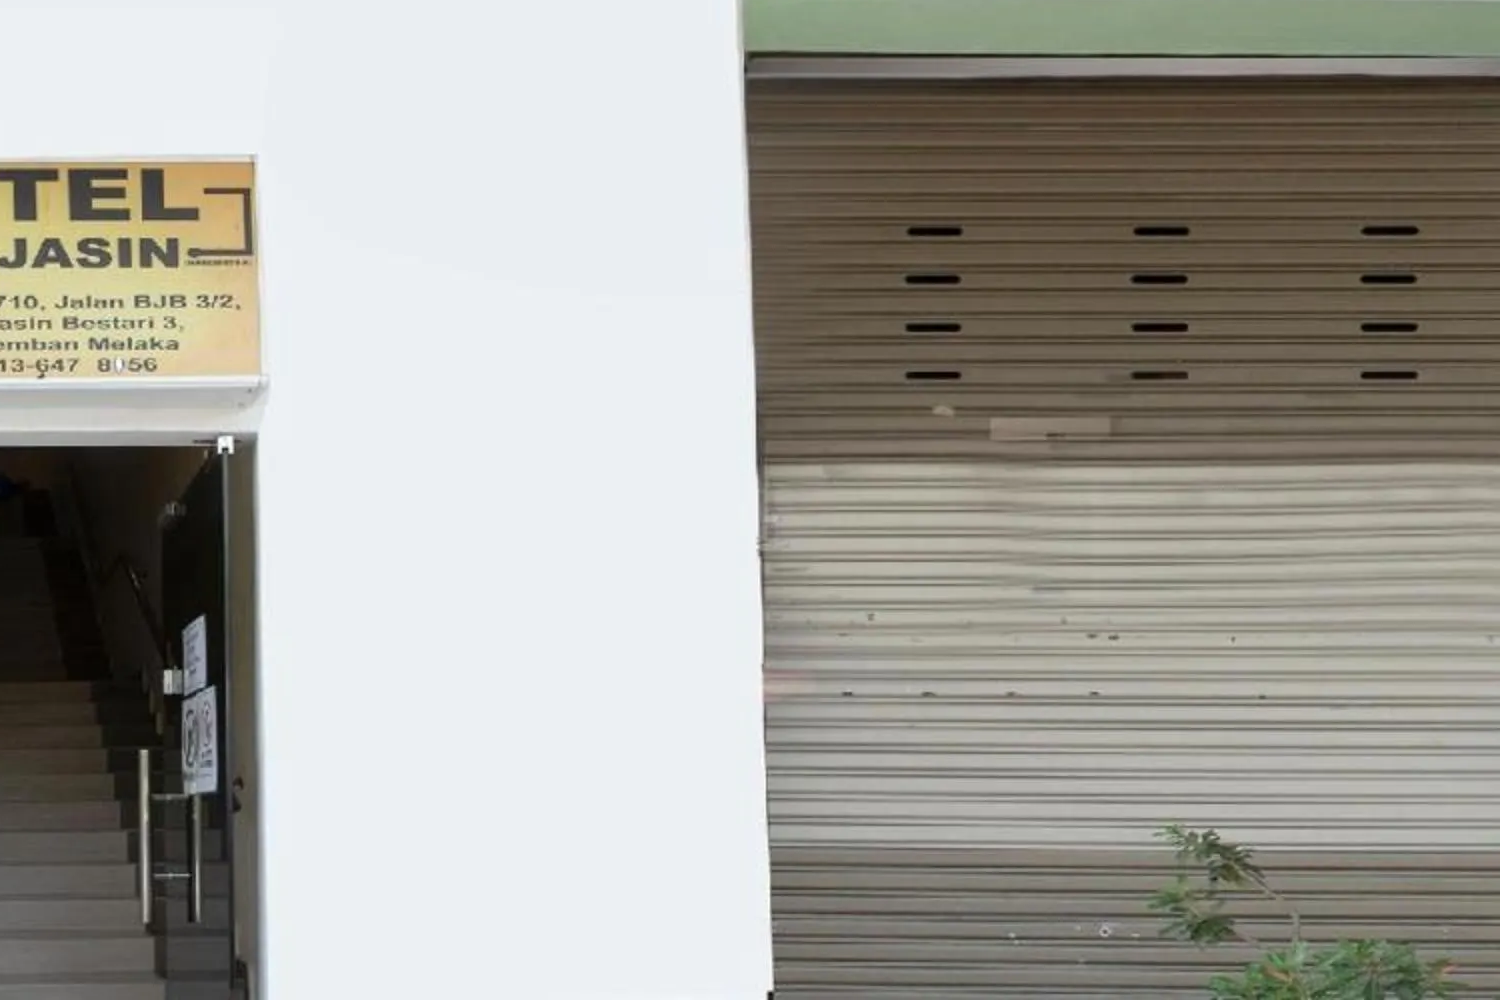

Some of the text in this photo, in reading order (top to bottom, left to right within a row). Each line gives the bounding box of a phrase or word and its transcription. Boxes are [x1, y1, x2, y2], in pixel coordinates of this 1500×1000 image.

[55, 294, 125, 310] Jalan
[133, 295, 187, 309] BJB
[195, 294, 241, 311] 3/2,
[62, 316, 154, 331] Bestari
[163, 315, 185, 333] 3,
[88, 337, 180, 351] Melaka
